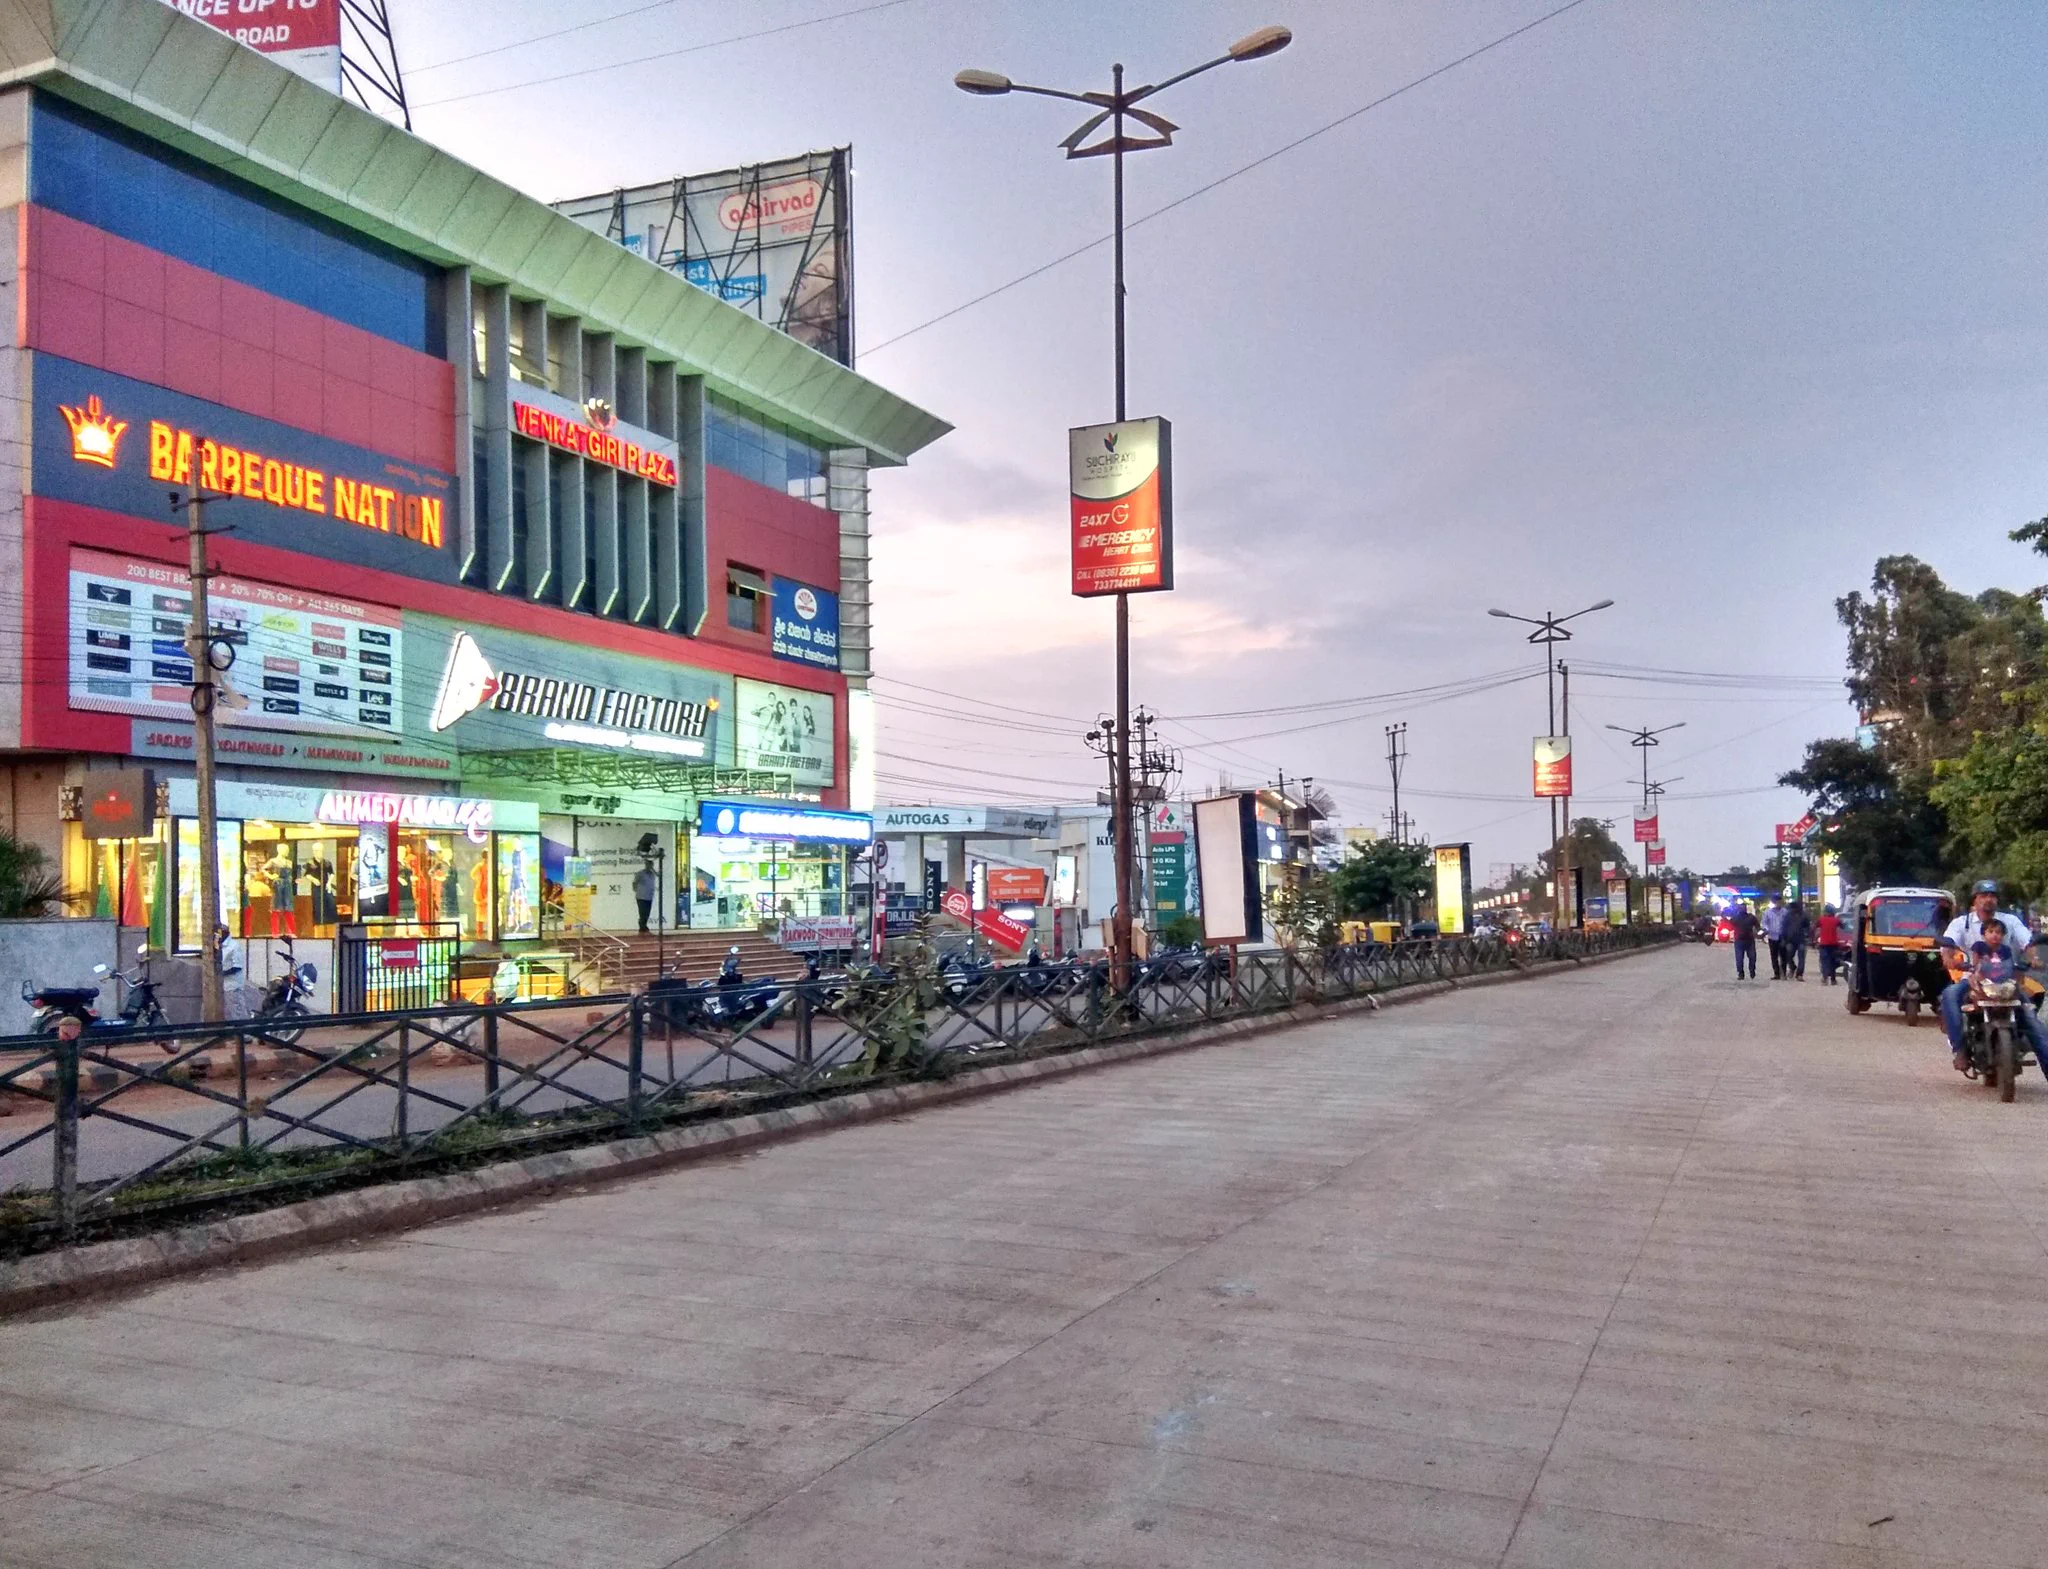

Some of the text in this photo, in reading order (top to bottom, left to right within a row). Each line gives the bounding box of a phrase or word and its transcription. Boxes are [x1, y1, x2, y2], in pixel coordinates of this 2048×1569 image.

[235, 25, 290, 45] ROAD
[728, 187, 815, 223] ashirvad
[149, 419, 443, 549] BARBEQUE NATION
[1080, 513, 1110, 528] 24X7
[1079, 527, 1155, 548] EMERGENCY
[127, 564, 147, 577] 200
[148, 568, 171, 582] BEST
[366, 691, 384, 704] Lee
[490, 671, 710, 738] BRAND FACTORY
[885, 813, 950, 825] AUTOGAS
[926, 865, 934, 910] SONY
[997, 914, 1028, 934] SONY
